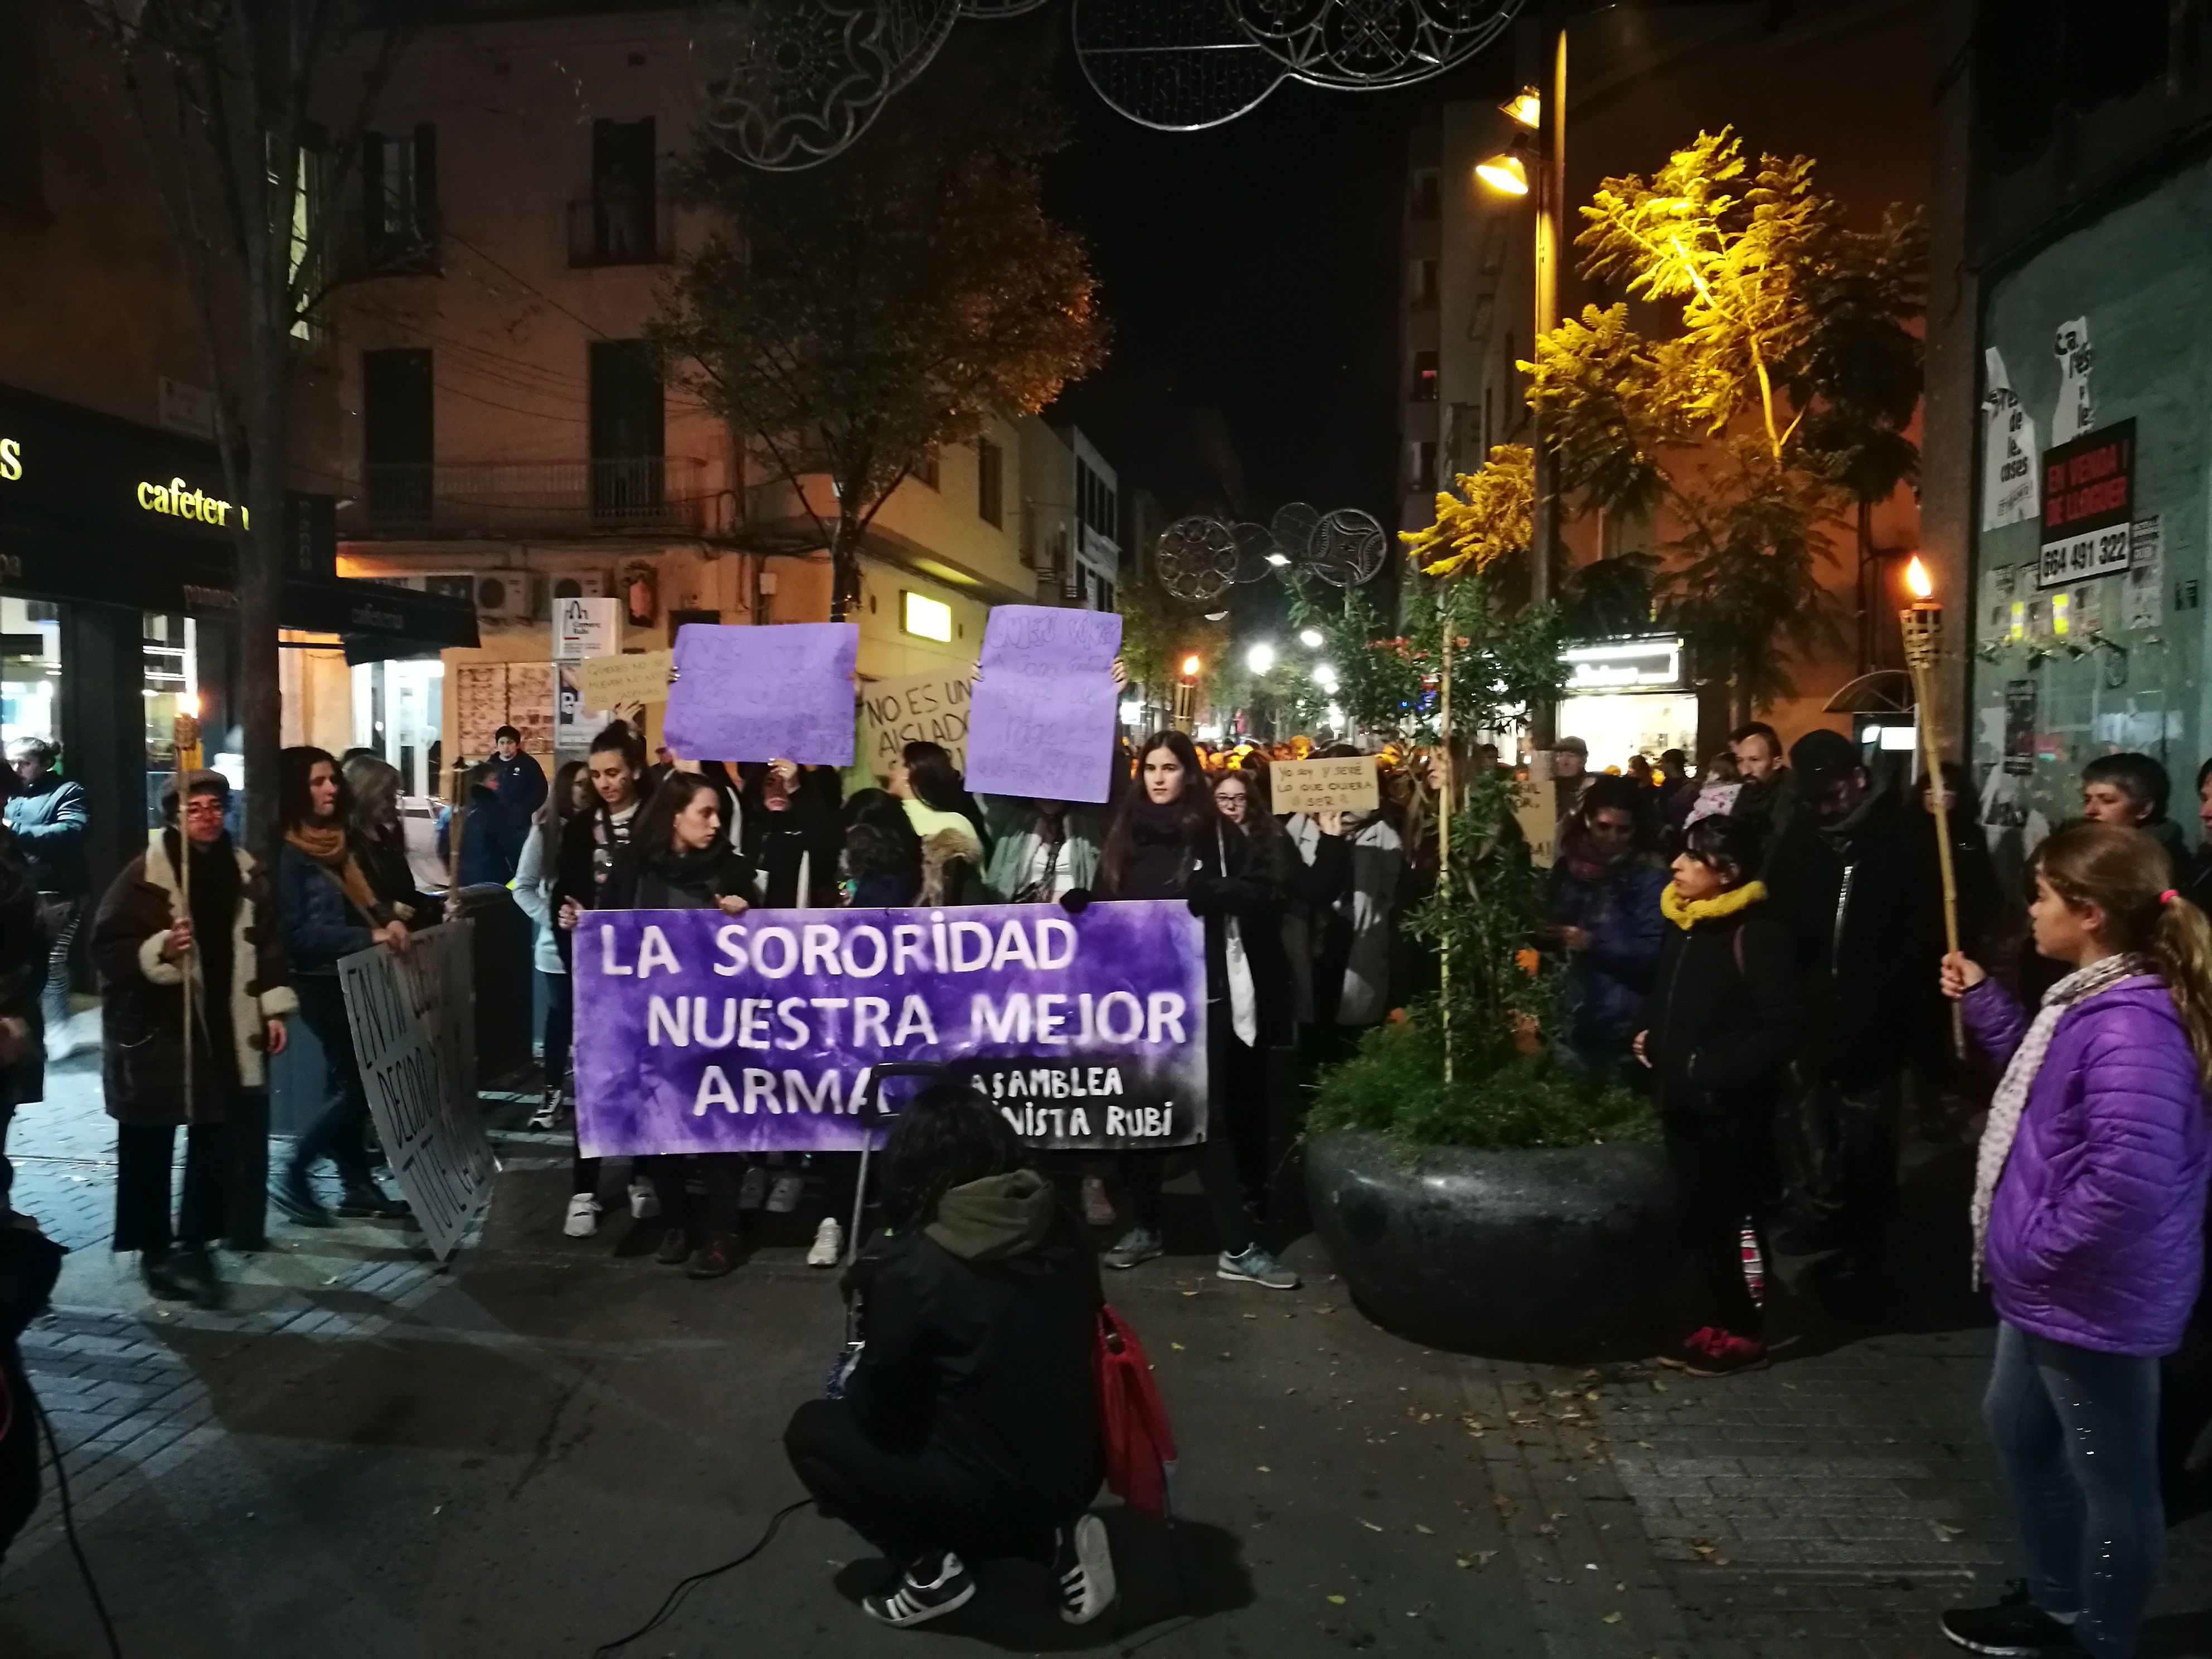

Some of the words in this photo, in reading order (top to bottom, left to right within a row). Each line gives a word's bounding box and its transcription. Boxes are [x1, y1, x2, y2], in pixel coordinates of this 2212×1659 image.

[2043, 546, 2066, 578] 664
[2069, 538, 2094, 571] 491
[2098, 531, 2126, 565] 322
[866, 695, 901, 729] NO
[905, 683, 940, 715] ES
[878, 709, 971, 758] AISLAD
[1277, 783, 1294, 793] LO
[1299, 783, 1324, 792] QUE
[1327, 782, 1374, 791] QUIERA
[1305, 795, 1335, 807] SER
[601, 924, 681, 978] LA
[347, 962, 386, 1070] EN
[647, 994, 939, 1050] NUESTRA
[970, 990, 1186, 1045] MEJOR
[692, 1065, 892, 1116] ARMA
[970, 1066, 1124, 1098] ASAMBLEA
